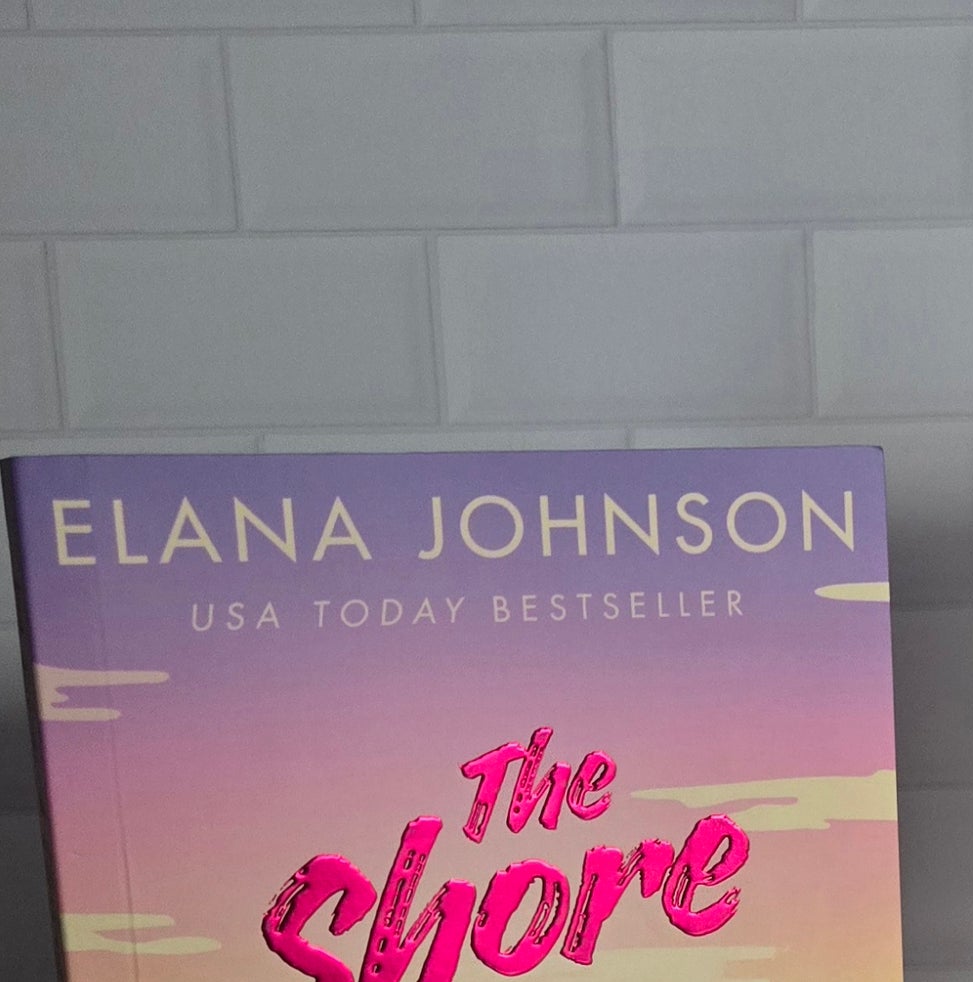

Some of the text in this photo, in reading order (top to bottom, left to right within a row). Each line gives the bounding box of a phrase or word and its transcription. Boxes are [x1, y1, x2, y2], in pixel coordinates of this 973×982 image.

[52, 490, 857, 566] ELANA JOHNSON
[190, 589, 746, 633] USA TODAY BESTSELLER
[460, 726, 618, 843] The
